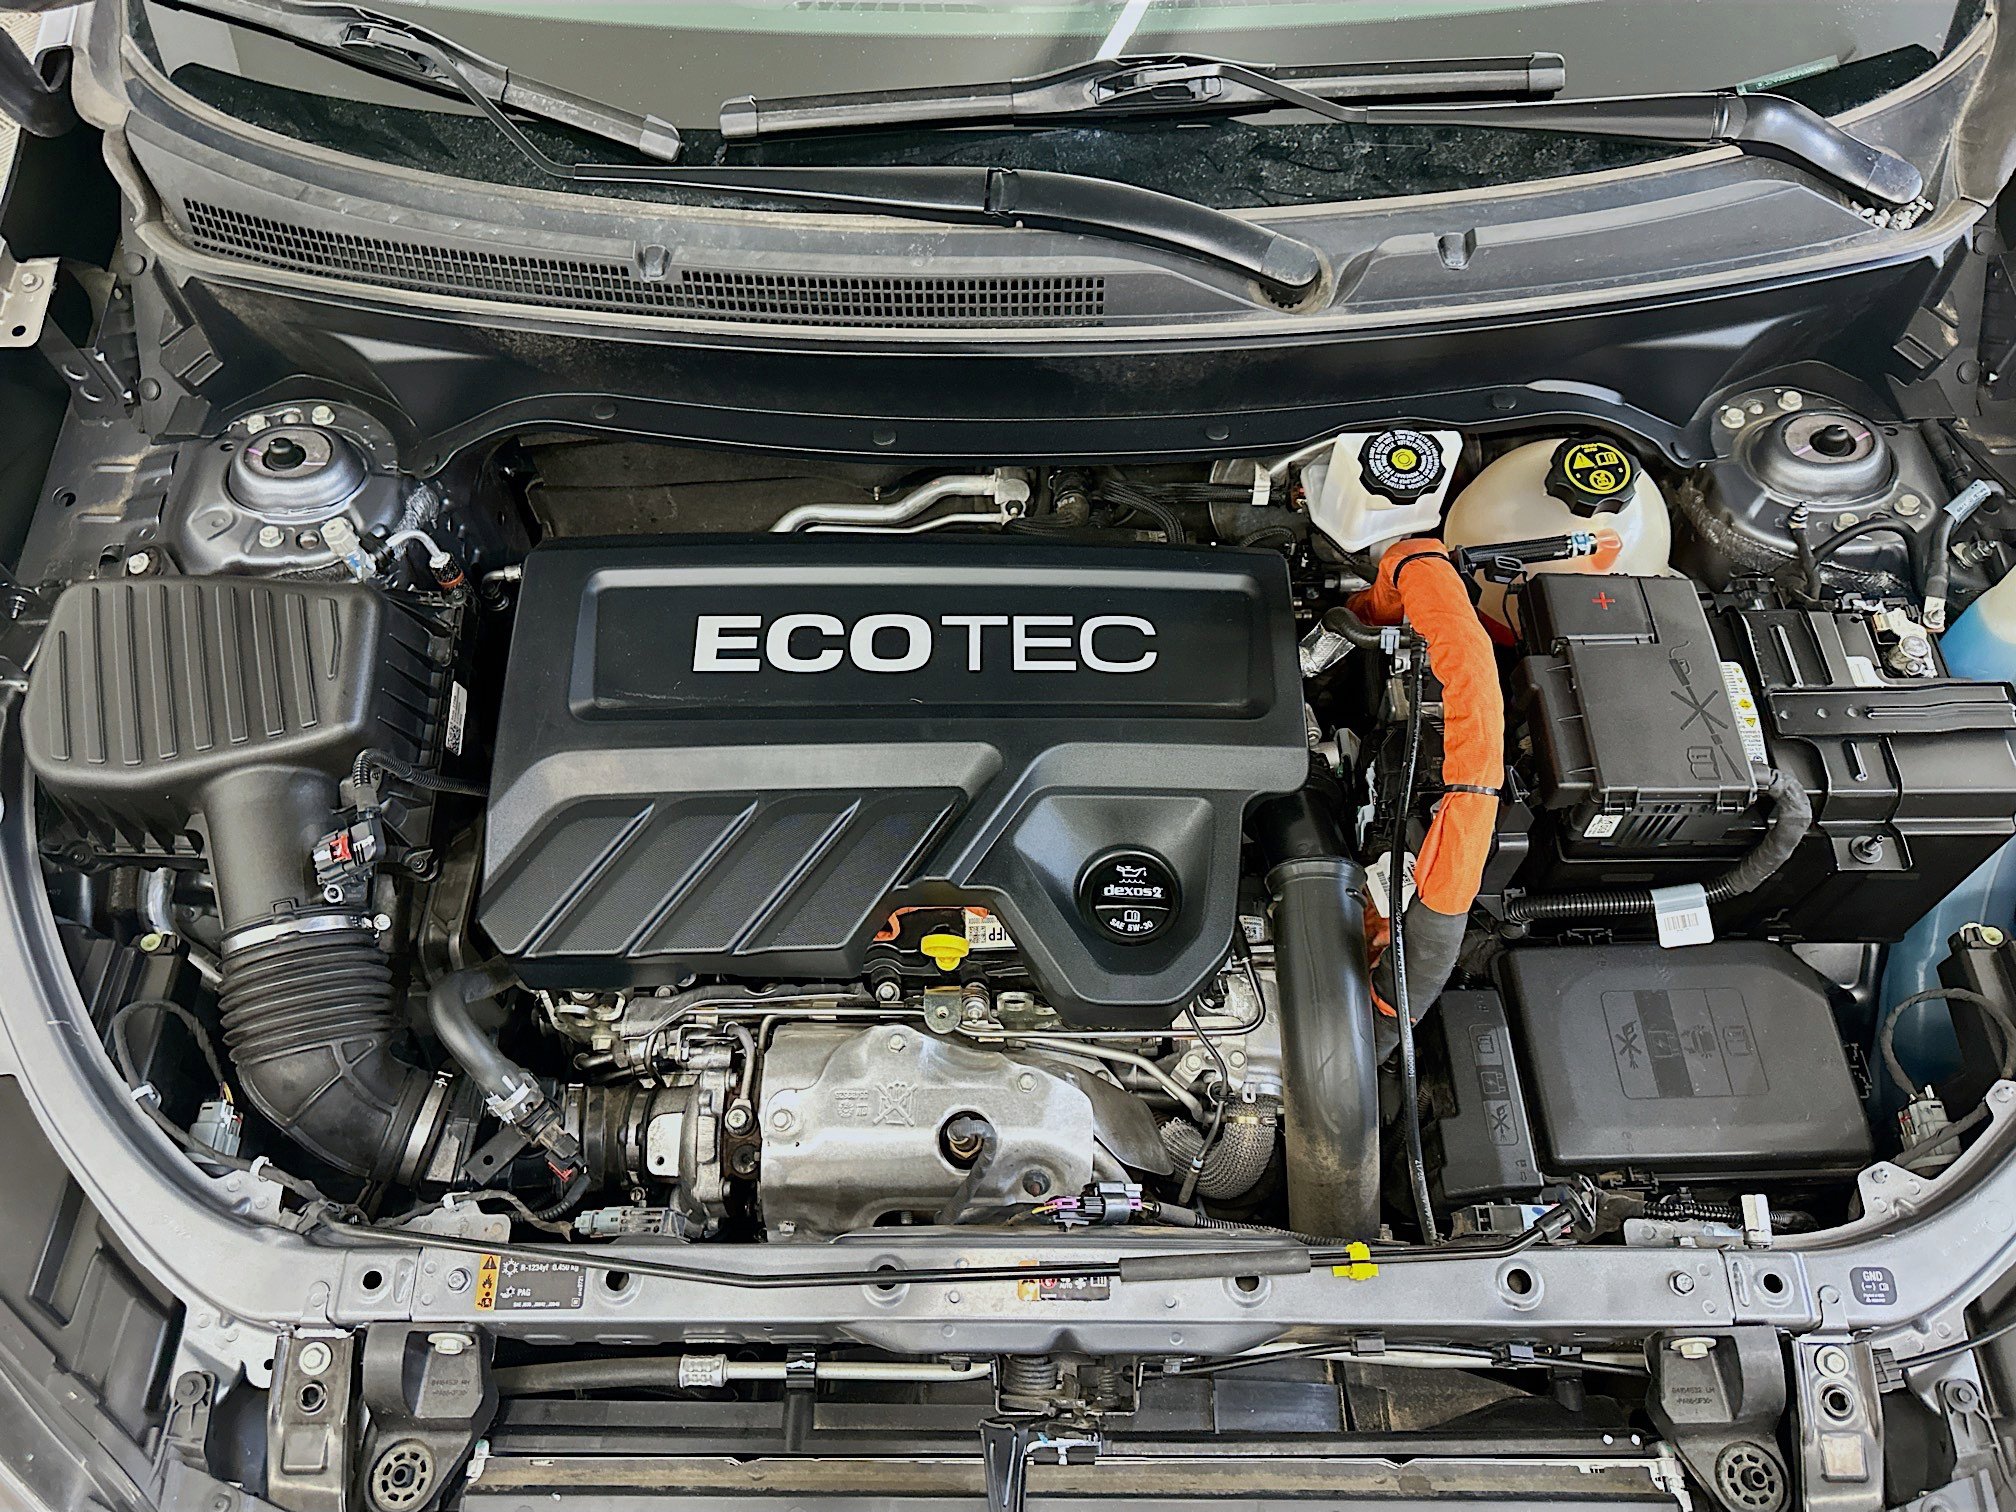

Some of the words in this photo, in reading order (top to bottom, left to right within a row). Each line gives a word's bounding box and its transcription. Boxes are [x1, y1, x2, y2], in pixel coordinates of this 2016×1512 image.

[693, 613, 1158, 673] ECOTEC
[1109, 918, 1126, 930] SAE
[1127, 920, 1154, 932] 5W-30
[520, 1263, 549, 1273] R-1234yf
[1862, 1270, 1883, 1282] GND
[516, 1288, 531, 1297] PAG
